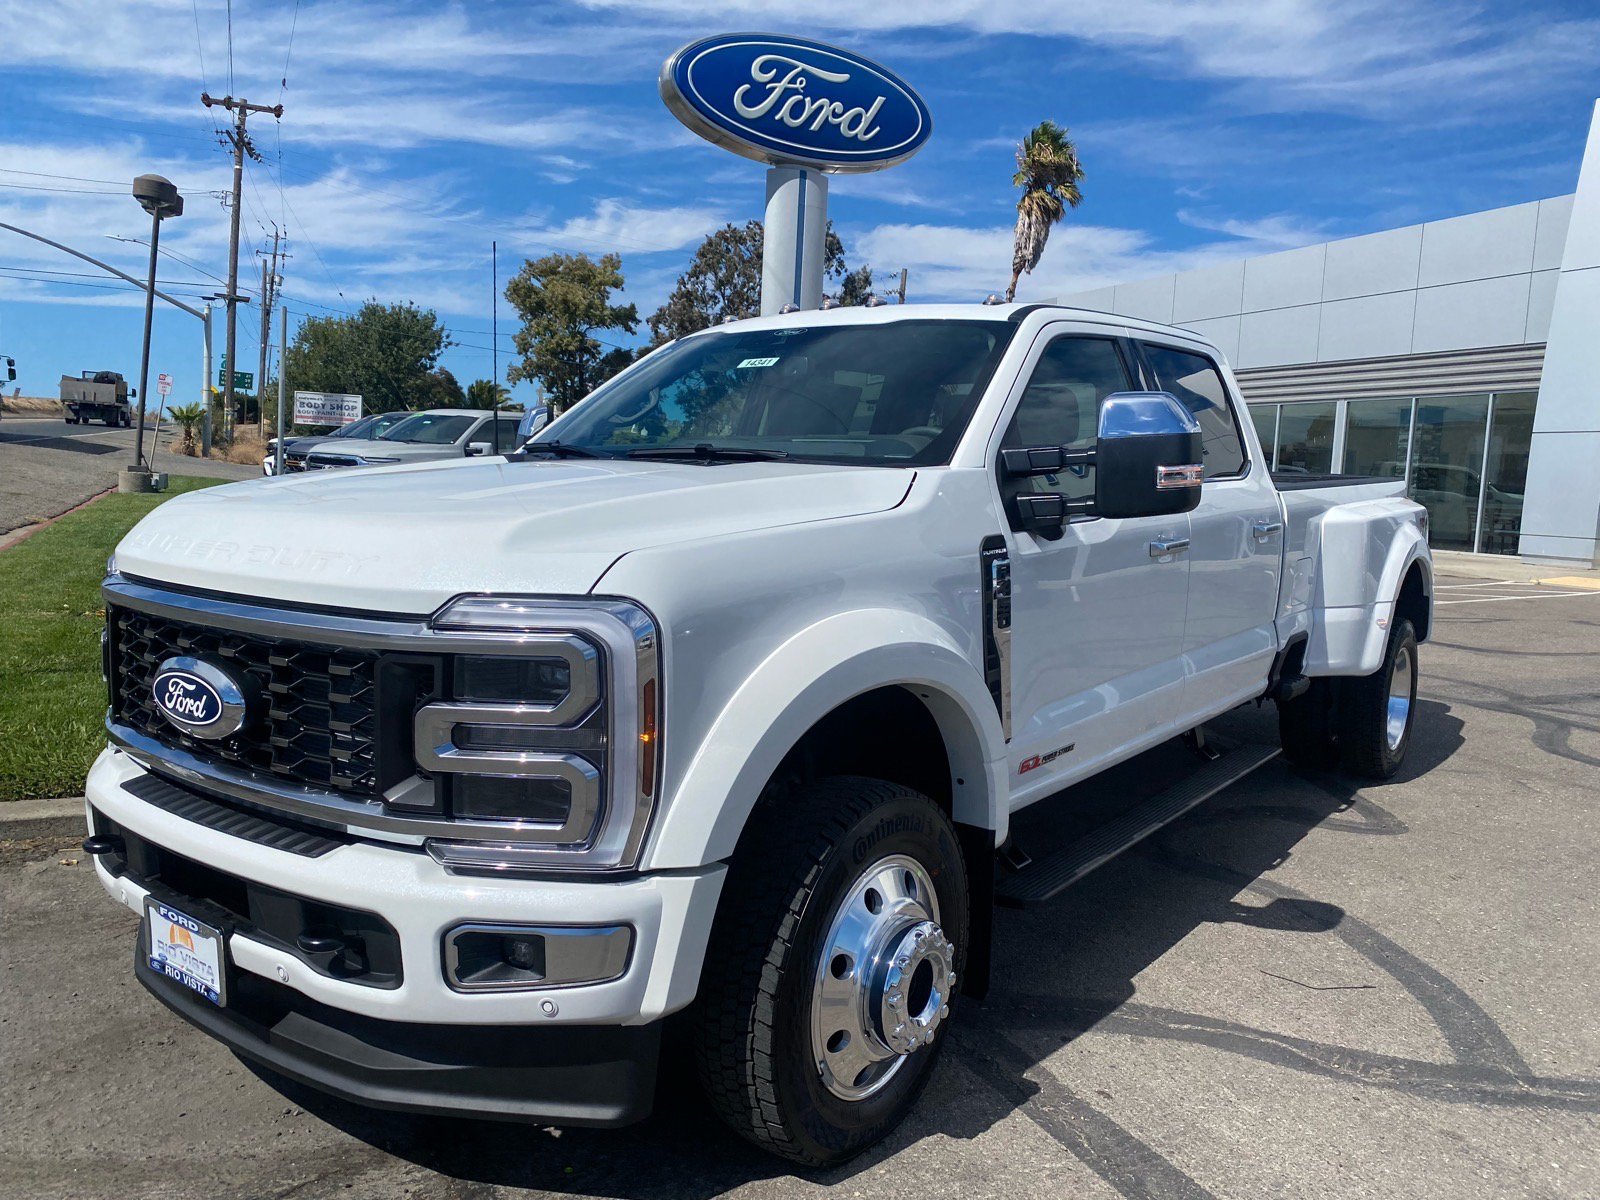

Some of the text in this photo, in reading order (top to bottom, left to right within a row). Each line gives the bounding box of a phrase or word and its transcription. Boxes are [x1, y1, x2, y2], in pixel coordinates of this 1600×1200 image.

[734, 54, 886, 142] Ford
[299, 402, 327, 410] BODY
[131, 532, 382, 576] SUPER DUTY
[165, 678, 207, 718] Ford
[852, 815, 924, 864] Continental
[159, 907, 199, 932] FORD
[158, 940, 215, 978] RIO VISTA
[165, 965, 181, 980] RIO
[182, 974, 208, 996] VISTA
